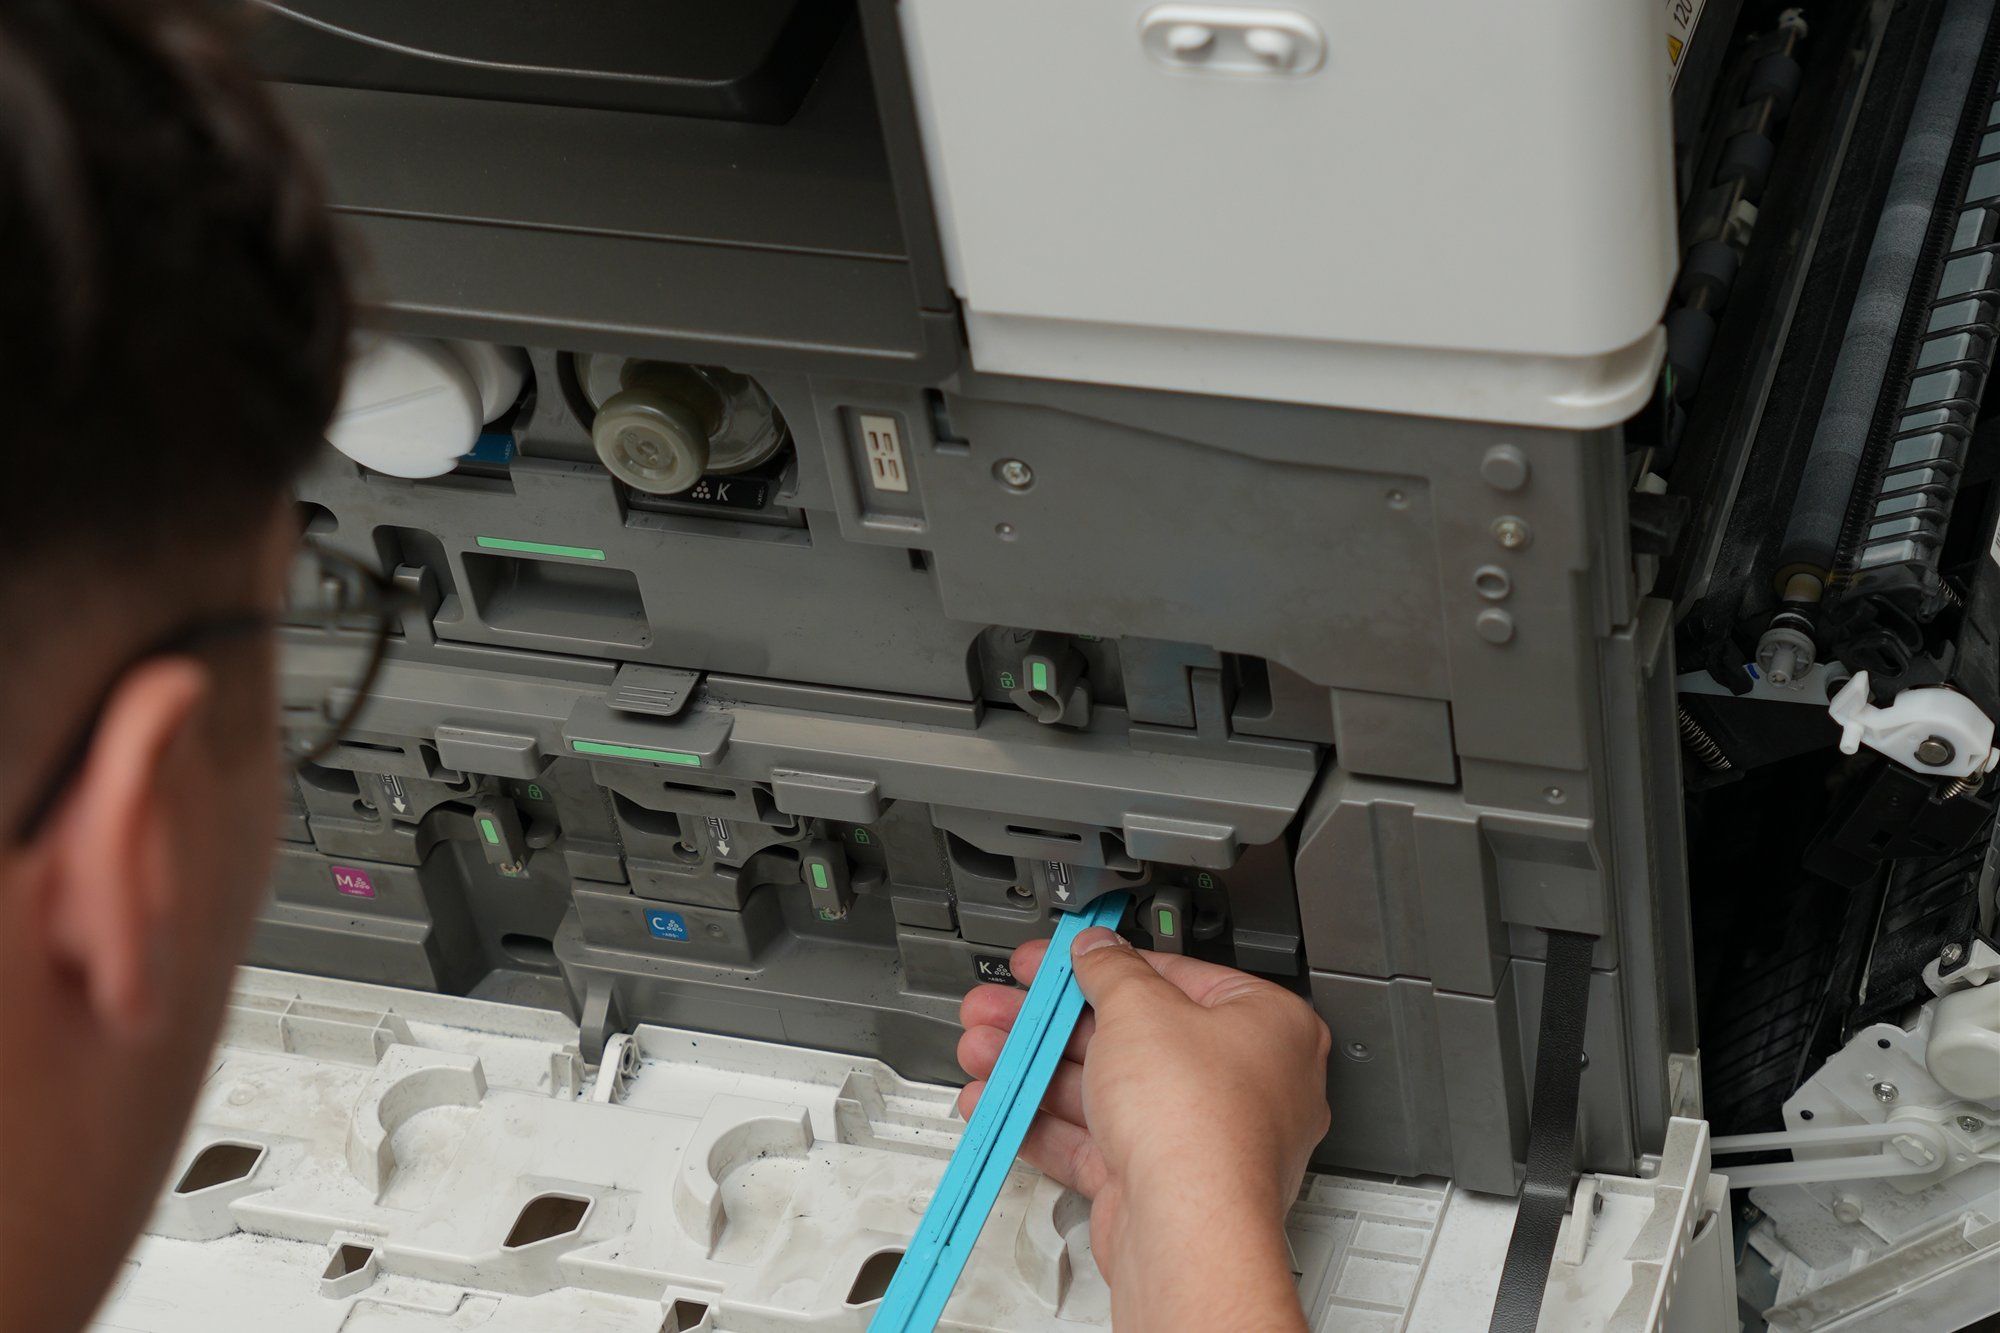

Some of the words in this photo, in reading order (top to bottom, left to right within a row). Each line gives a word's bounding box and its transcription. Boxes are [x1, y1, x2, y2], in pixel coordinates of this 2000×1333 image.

[716, 483, 732, 502] K
[335, 873, 354, 888] M
[652, 917, 666, 930] C
[979, 961, 993, 975] K
